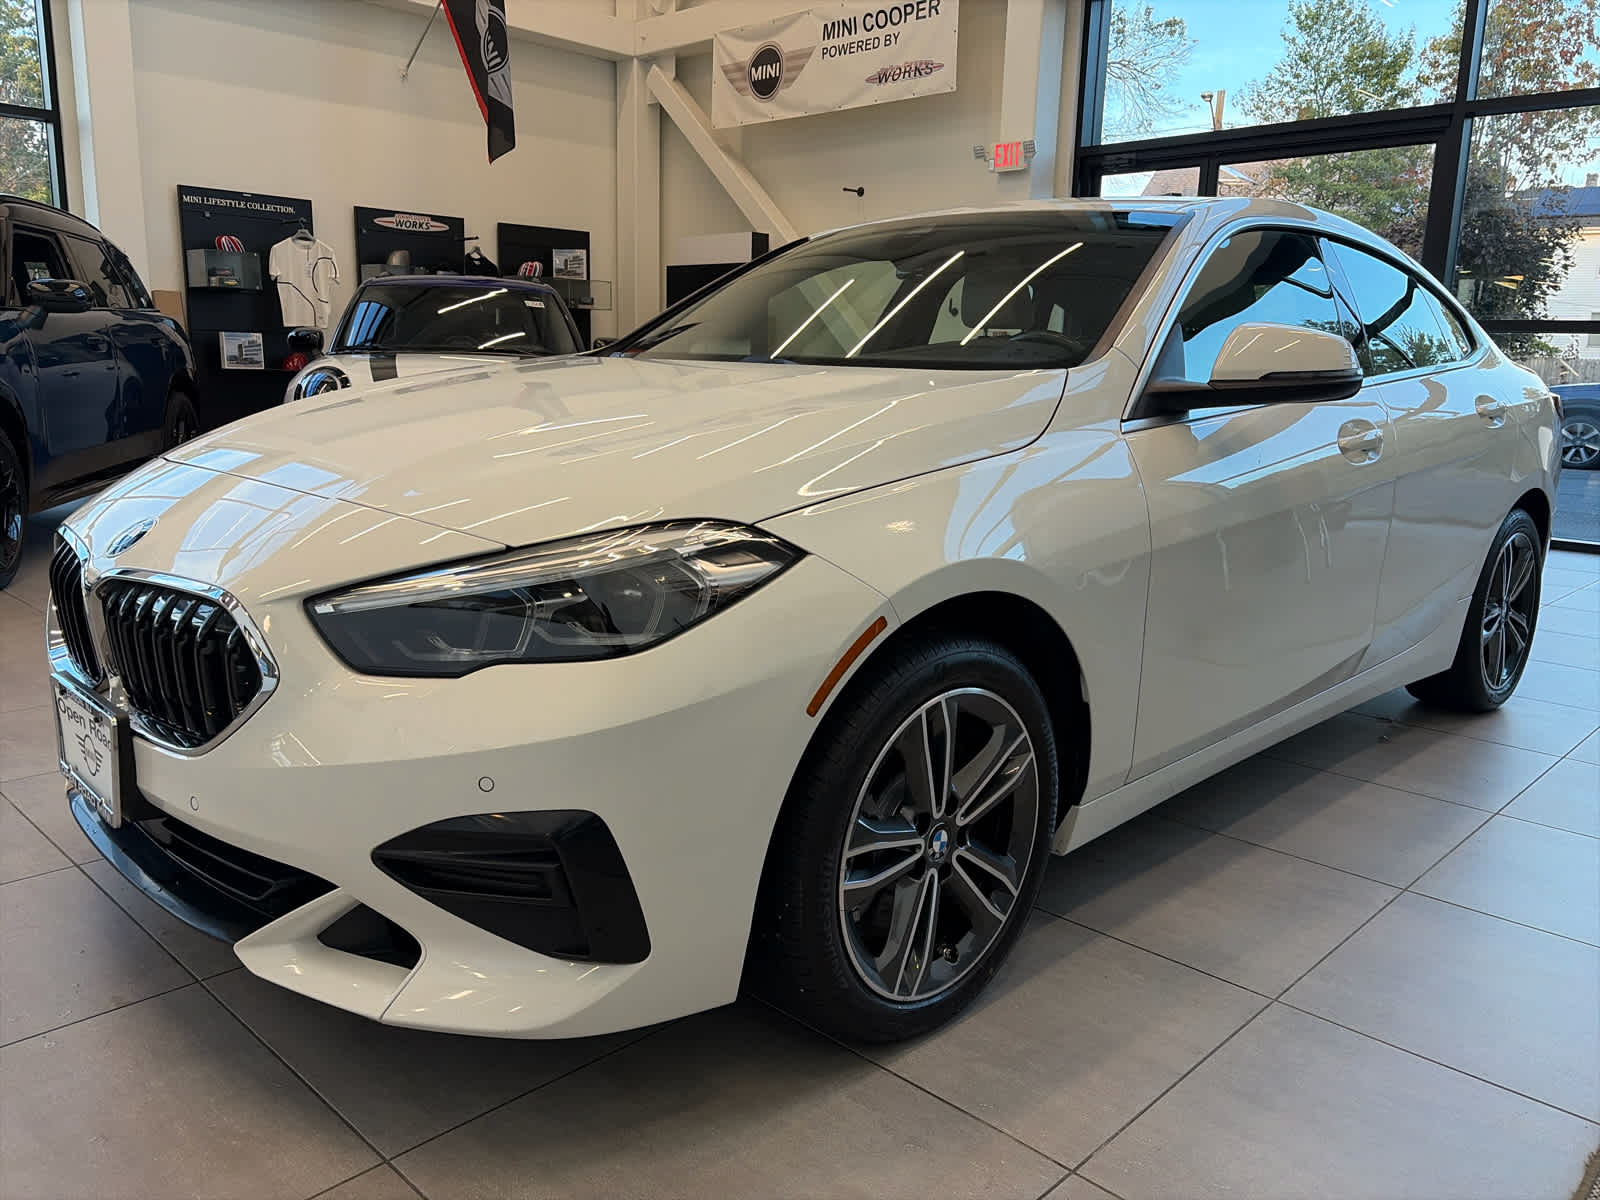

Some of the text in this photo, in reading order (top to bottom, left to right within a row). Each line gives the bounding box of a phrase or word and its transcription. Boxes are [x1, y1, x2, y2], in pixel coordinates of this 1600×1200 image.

[822, 0, 941, 41] MINI COOPER
[821, 31, 901, 60] POWERED BY
[751, 62, 780, 82] MINI
[877, 62, 934, 84] WORKS
[994, 142, 1021, 168] EXIT
[182, 194, 202, 204] MINI
[204, 197, 246, 209] LIFESTYLE
[395, 219, 431, 231] WORKS
[57, 697, 87, 729] Open
